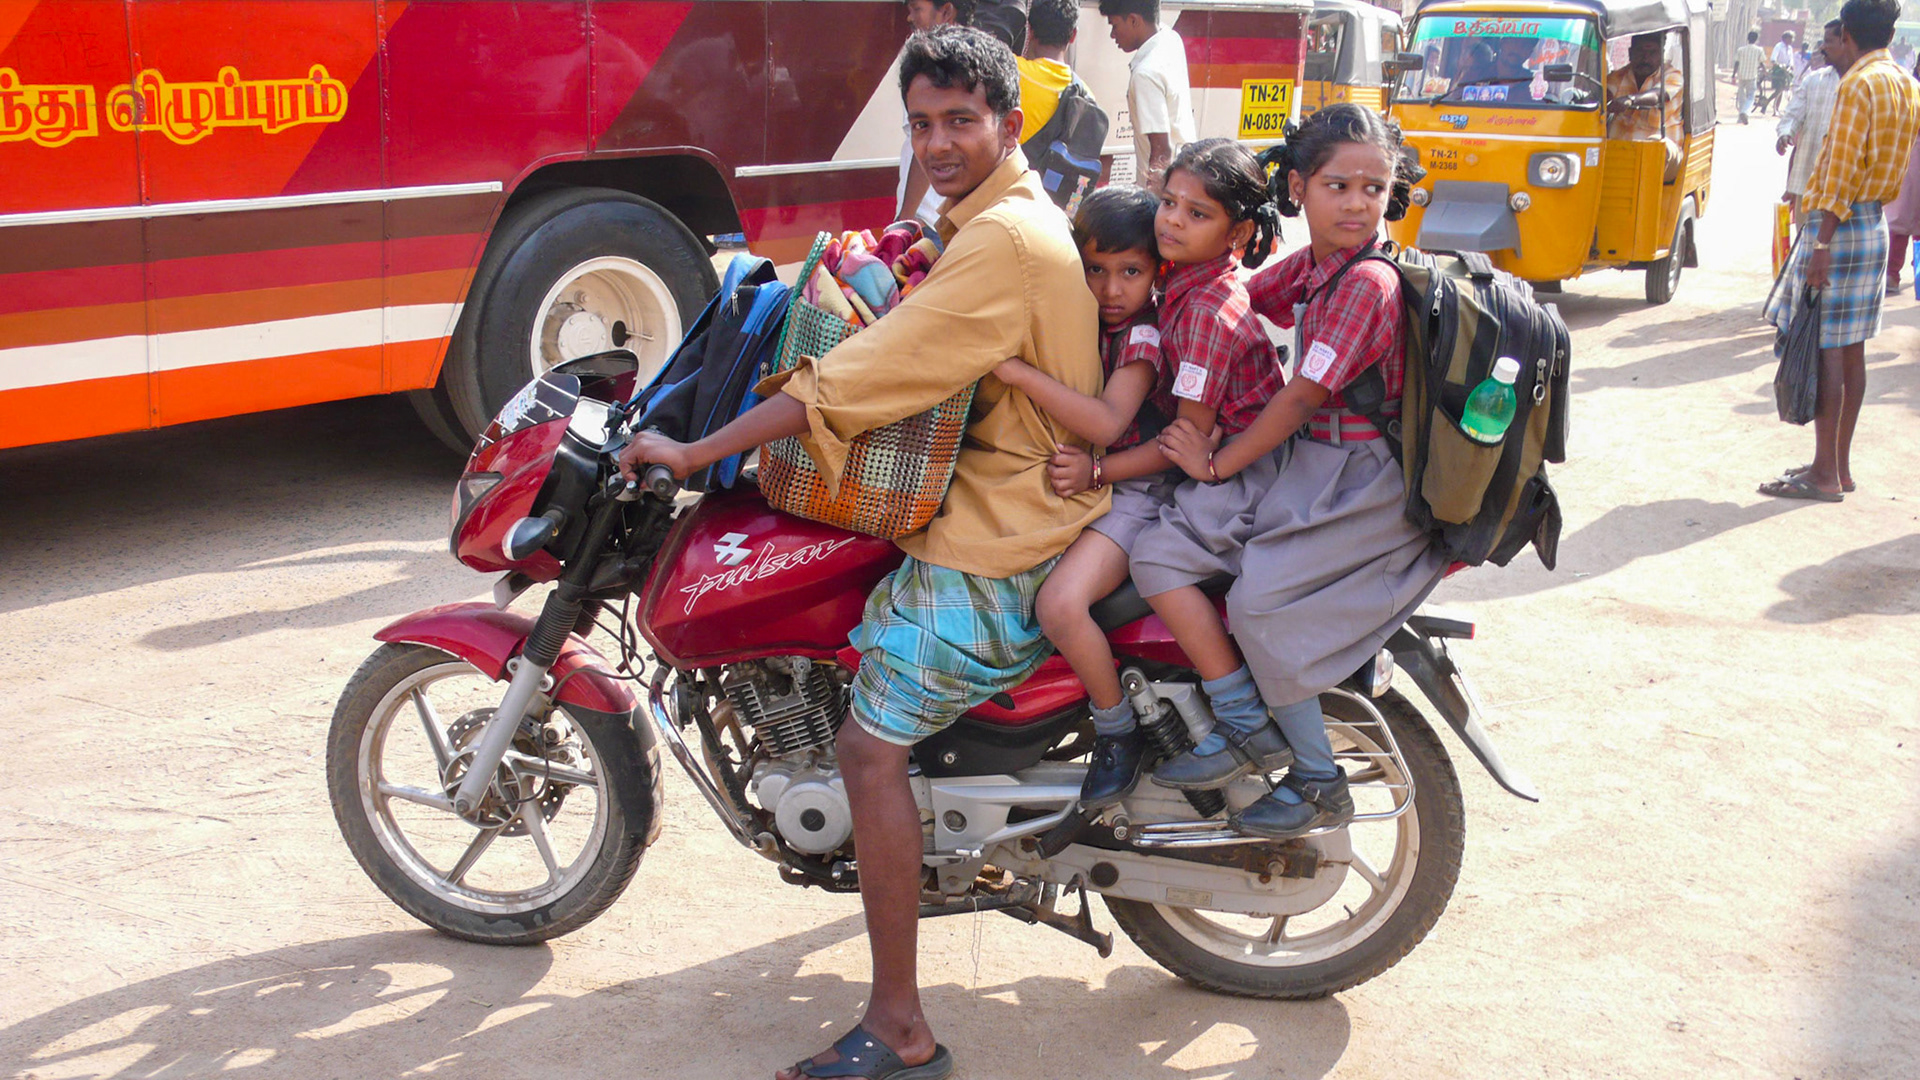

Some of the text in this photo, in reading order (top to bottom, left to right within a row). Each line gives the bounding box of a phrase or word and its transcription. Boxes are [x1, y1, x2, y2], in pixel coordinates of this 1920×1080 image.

[1249, 85, 1287, 102] TN-21
[106, 64, 348, 145] விழுப்புரம்
[1242, 113, 1286, 131] N-0837
[1430, 148, 1458, 159] TN-21
[1430, 161, 1458, 171] M-2368
